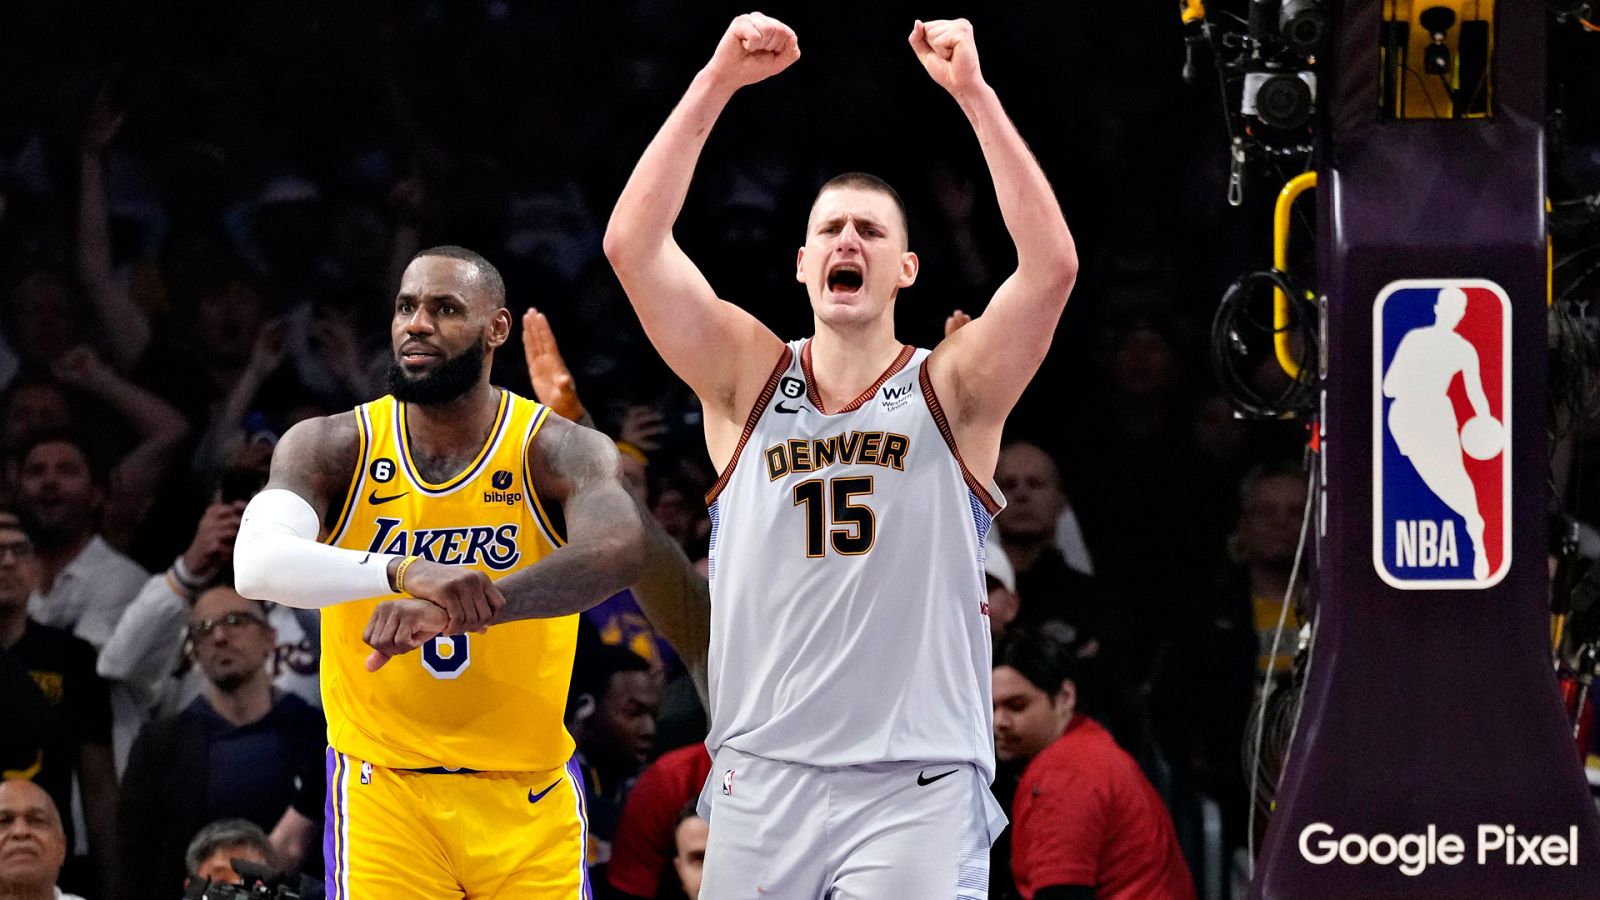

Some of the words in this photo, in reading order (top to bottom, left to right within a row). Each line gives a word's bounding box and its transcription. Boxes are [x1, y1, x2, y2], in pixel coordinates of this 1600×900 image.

[784, 380, 801, 396] 6
[883, 383, 912, 400] WU
[882, 394, 912, 407] Western
[887, 401, 908, 412] Union
[765, 431, 910, 482] DENVER
[375, 461, 391, 480] 6
[484, 492, 521, 505] bibigo
[793, 475, 875, 558] 15
[368, 516, 521, 571] LAKERS
[1395, 519, 1459, 567] NBA
[1299, 822, 1465, 876] Google
[1477, 824, 1578, 866] Pixel
